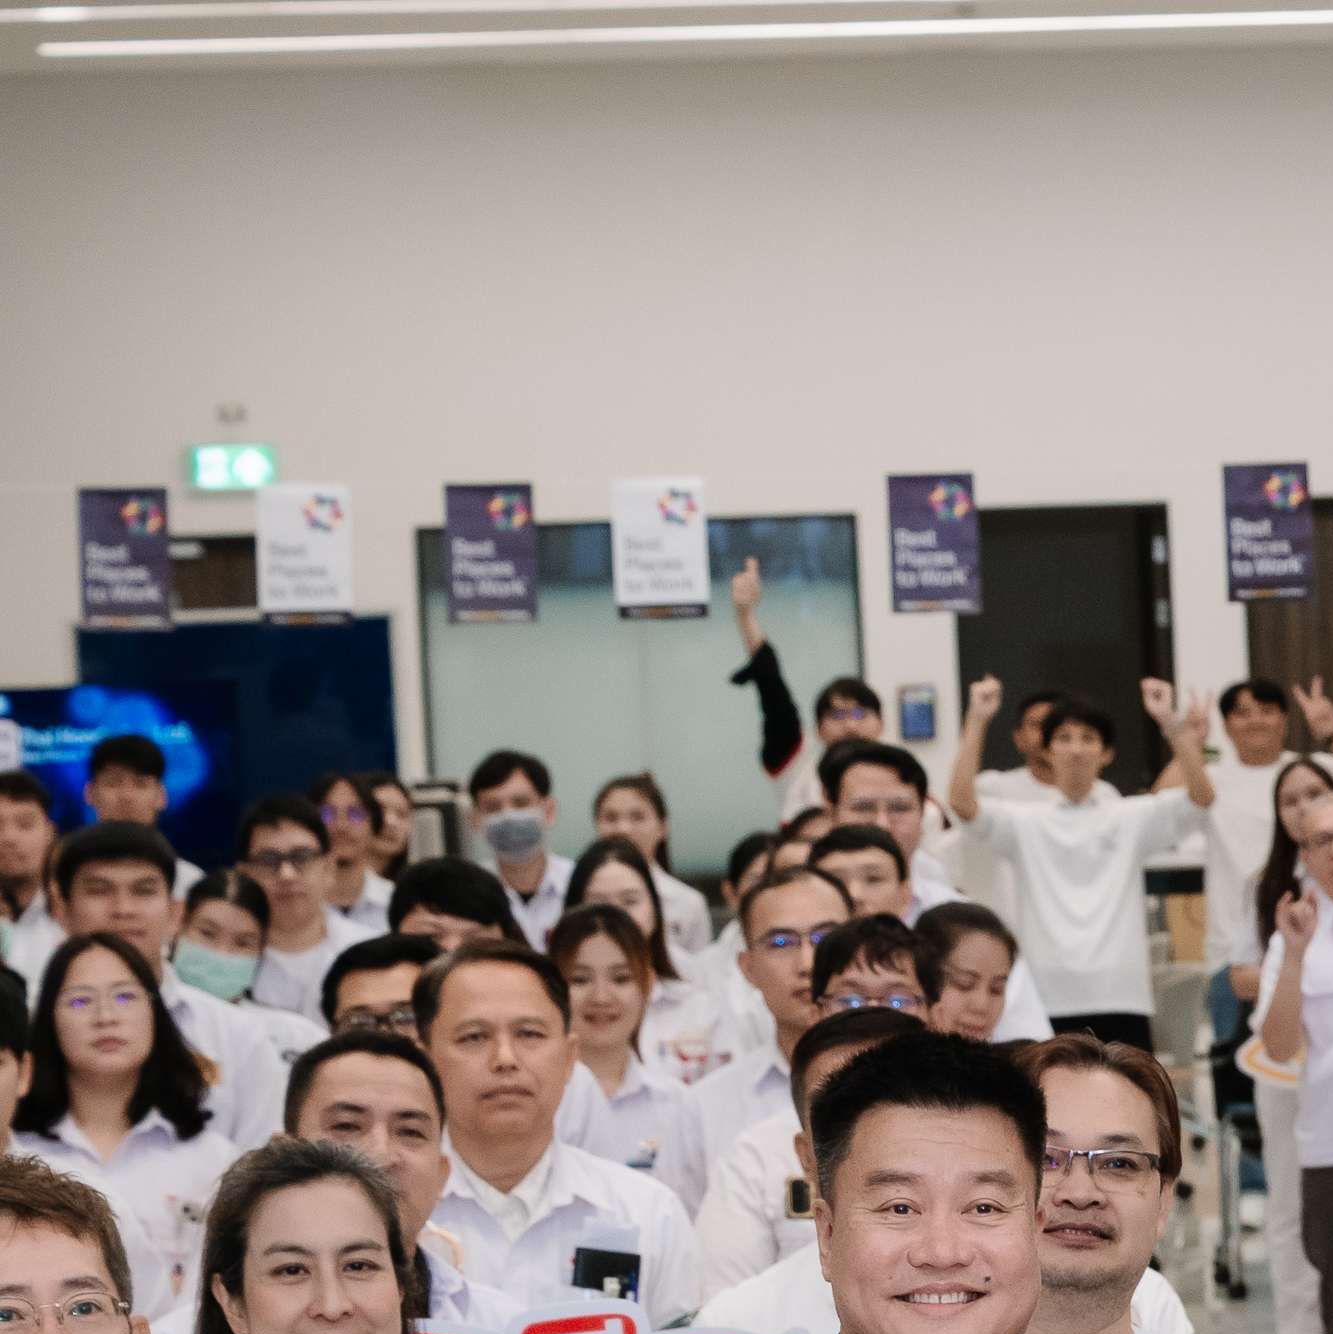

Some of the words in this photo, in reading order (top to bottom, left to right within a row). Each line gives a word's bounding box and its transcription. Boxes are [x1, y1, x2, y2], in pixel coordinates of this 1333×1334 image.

[1230, 518, 1271, 537] Best
[452, 537, 496, 556] Best
[894, 528, 937, 547] Best
[1231, 538, 1291, 556] Places
[85, 543, 128, 561] Best
[894, 548, 957, 568] Places
[85, 563, 149, 583] Places
[452, 558, 515, 577] Places
[1232, 558, 1254, 577] to
[895, 569, 918, 587] to
[86, 585, 108, 602] to
[453, 579, 475, 597] to
